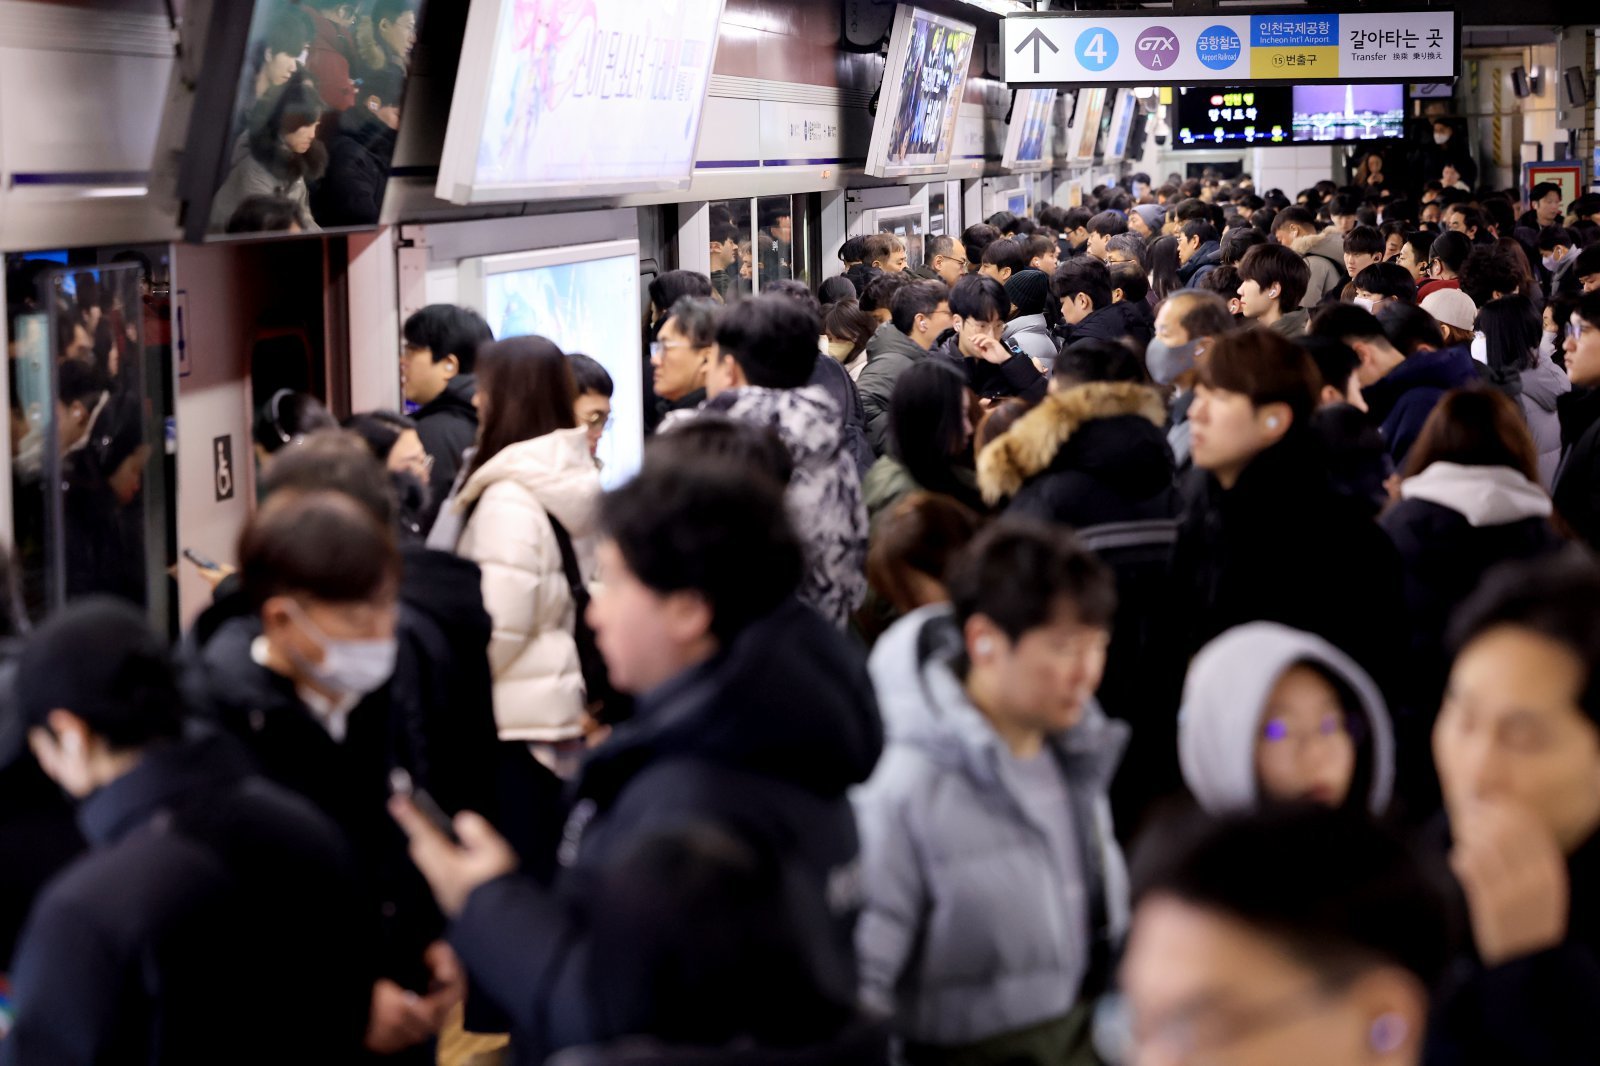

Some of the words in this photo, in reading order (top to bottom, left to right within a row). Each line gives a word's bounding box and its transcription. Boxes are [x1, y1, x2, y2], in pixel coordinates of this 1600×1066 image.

[1259, 21, 1331, 36] 인천국제공항
[1138, 36, 1175, 51] GTX
[1197, 35, 1240, 51] 공항철도
[1259, 36, 1289, 45] Incheon
[1304, 36, 1329, 45] Airport
[1350, 28, 1420, 50] 갈아타는
[1425, 28, 1444, 48] 곳
[1083, 33, 1108, 64] 4
[1351, 51, 1387, 61] Transfer
[1151, 53, 1162, 67] A
[1201, 53, 1218, 62] Airport
[1218, 52, 1237, 61] Railroad
